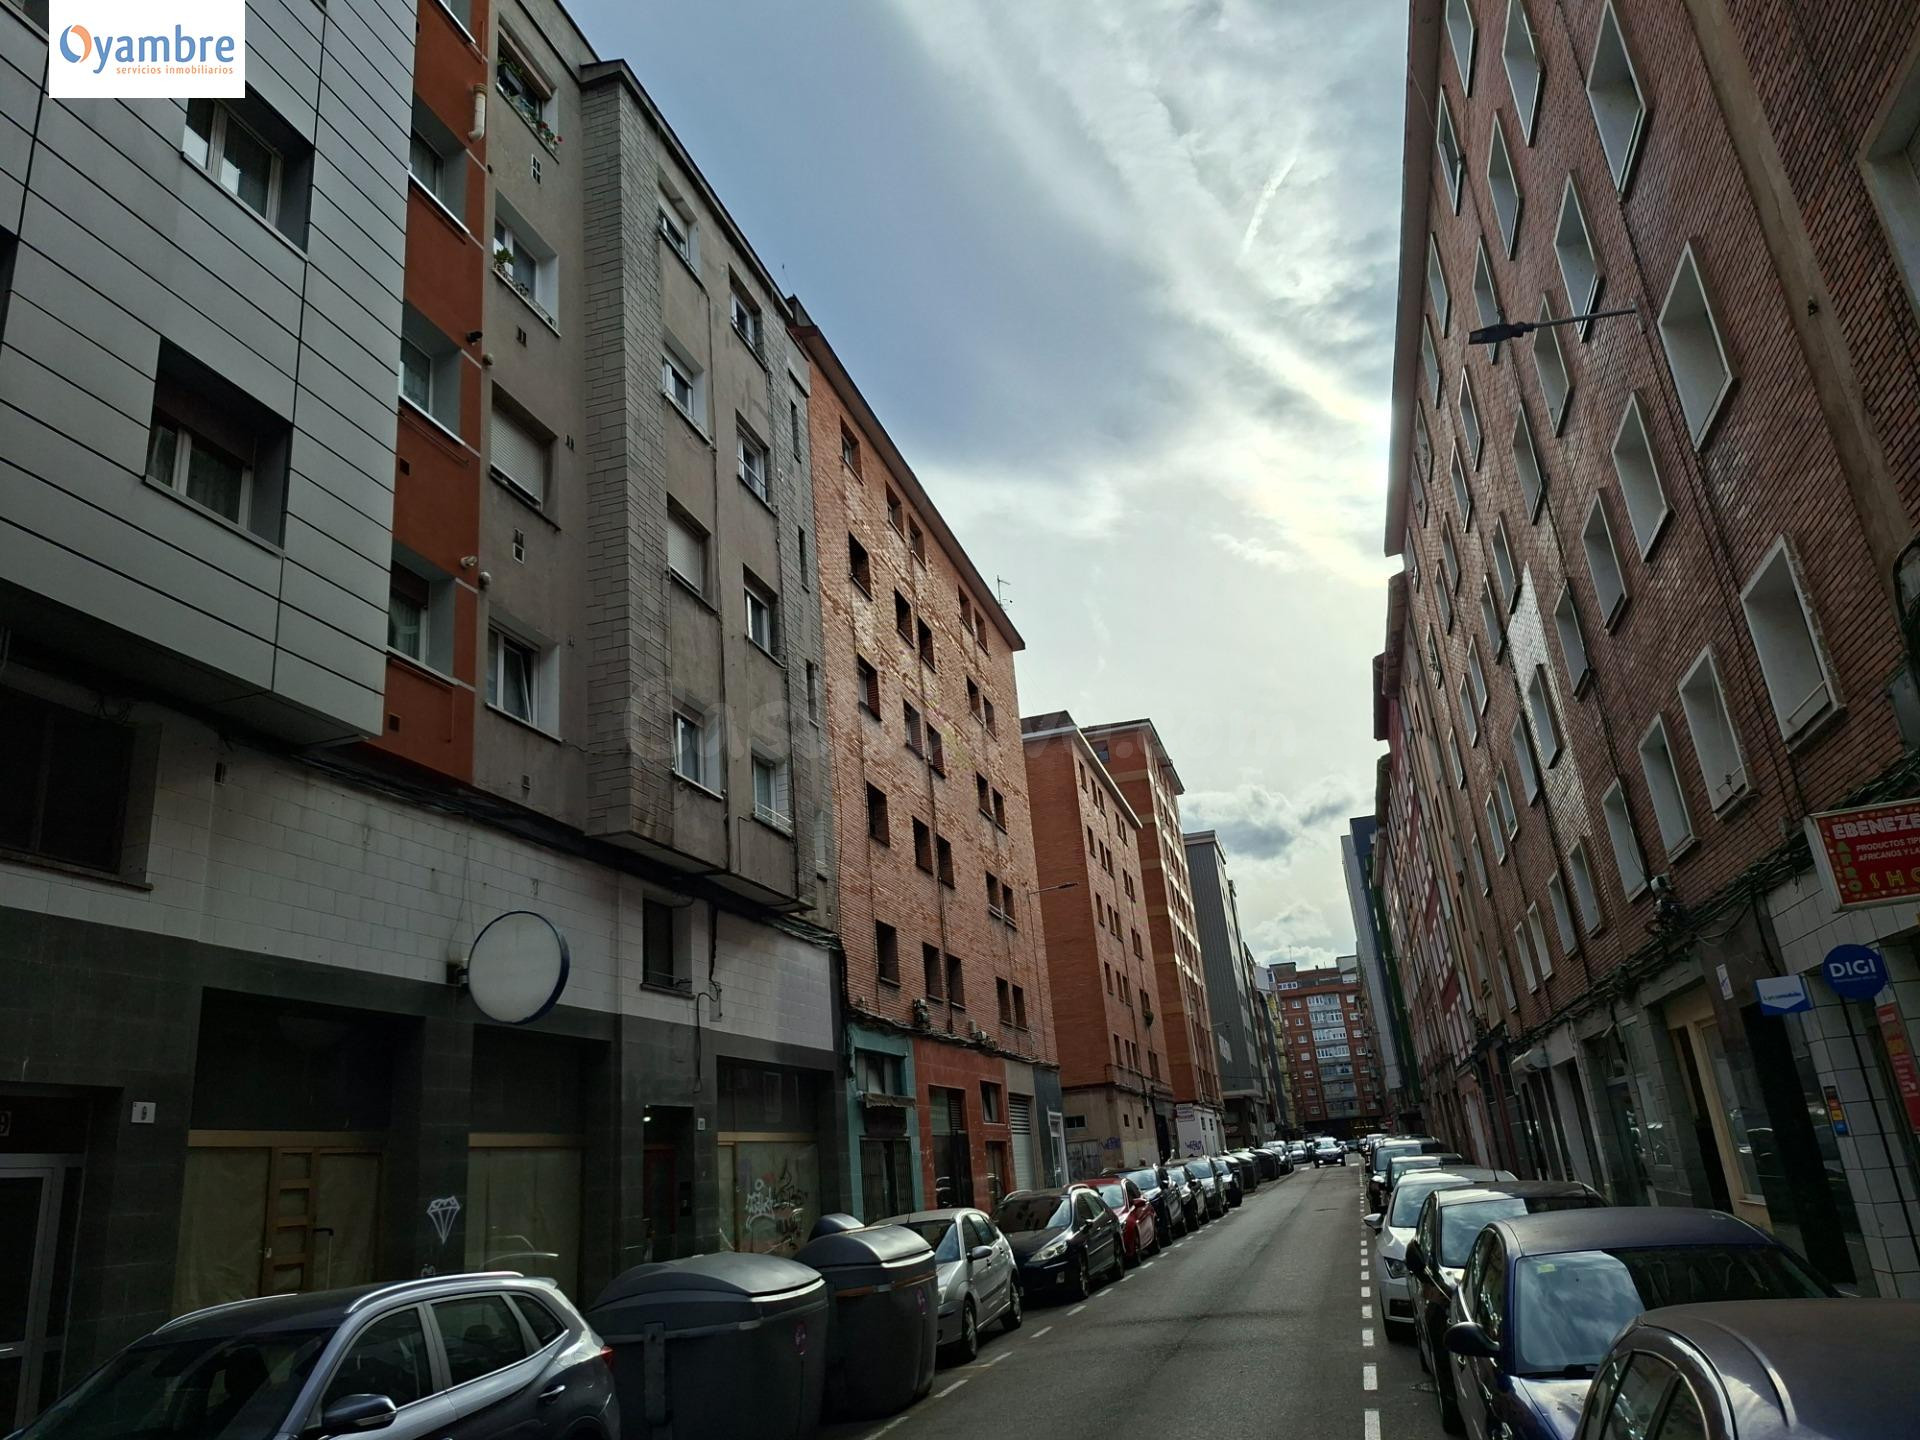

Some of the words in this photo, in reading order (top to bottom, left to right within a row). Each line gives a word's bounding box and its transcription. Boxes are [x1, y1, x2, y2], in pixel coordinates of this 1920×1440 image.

[1856, 839, 1905, 852] PRODUCTOS
[1858, 849, 1903, 862] AFRICANOS
[1828, 959, 1876, 977] DIGI
